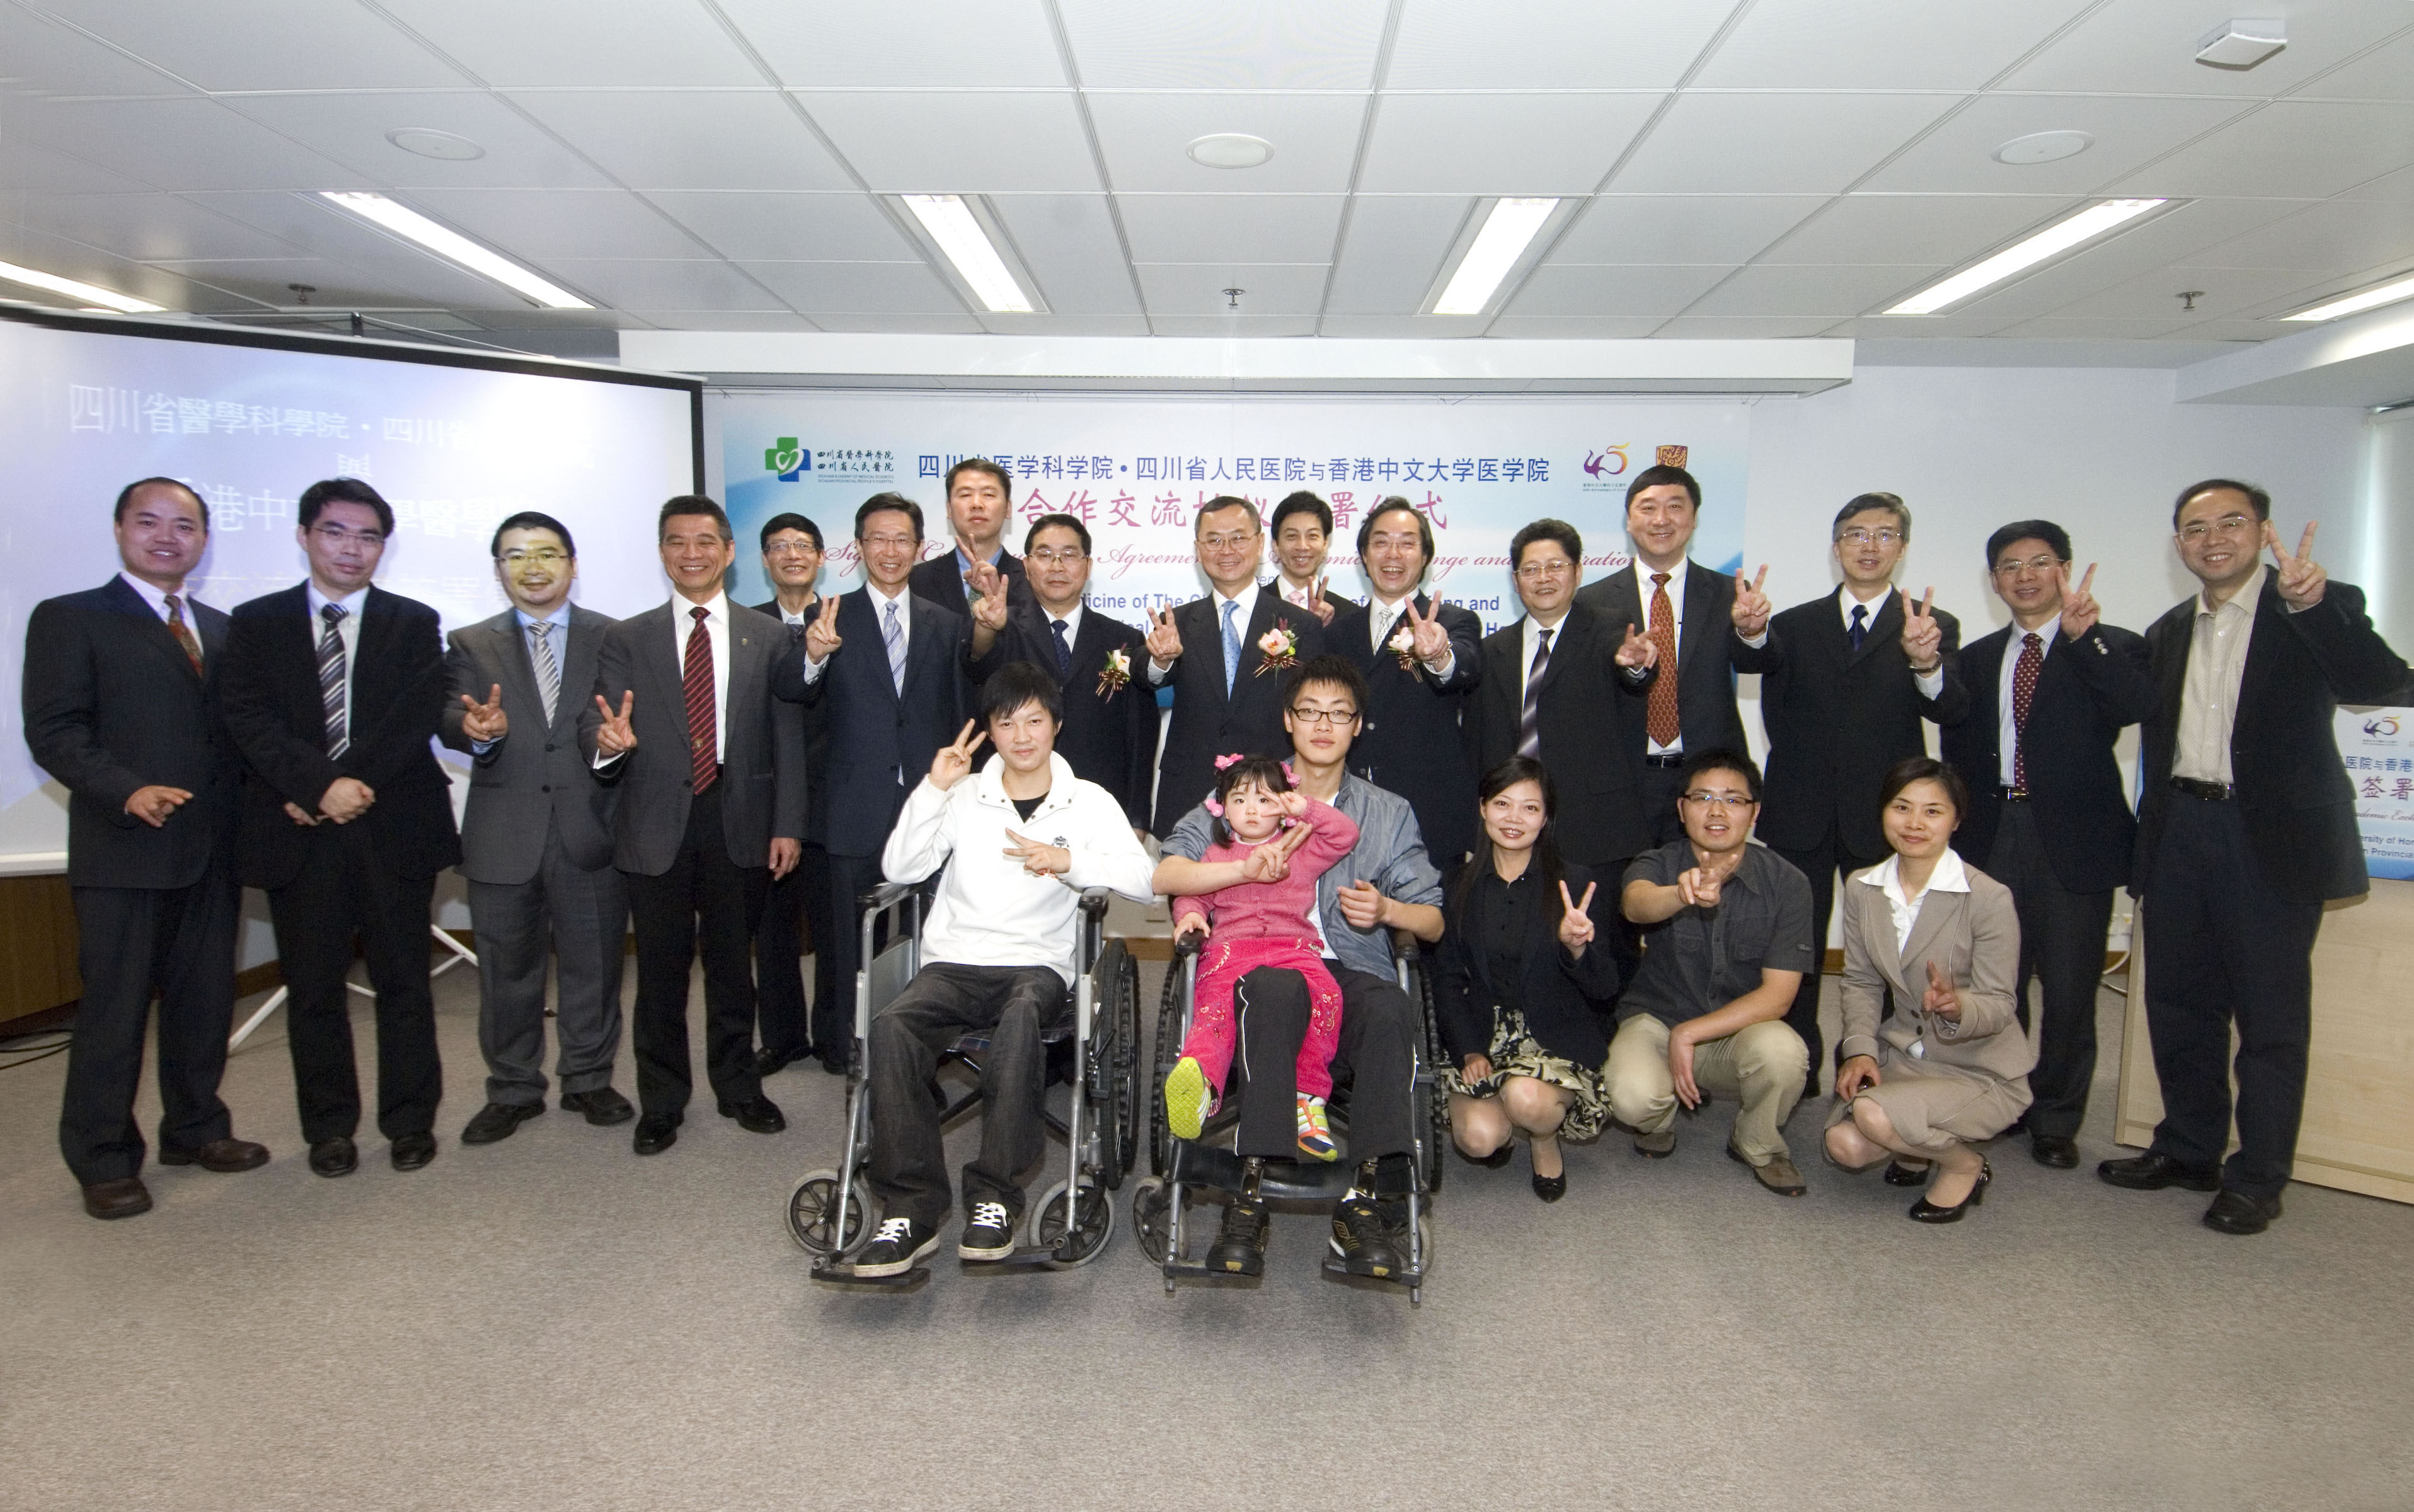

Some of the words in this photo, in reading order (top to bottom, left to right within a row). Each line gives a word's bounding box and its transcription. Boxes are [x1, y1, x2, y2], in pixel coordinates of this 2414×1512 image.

[817, 449, 894, 461] 四川省醫學科學院
[817, 461, 894, 472] 四川省人民醫院
[919, 454, 1549, 483] 四川医学科学院·四川省人民医院与香港中文大学医学院
[1097, 544, 1201, 580] Agreeme
[1083, 593, 1126, 608] icine
[1132, 594, 1148, 608] of
[1154, 593, 1183, 609] The
[1469, 596, 1500, 610] and
[2360, 776, 2414, 801] 签署
[2359, 835, 2384, 845] ersity
[2399, 837, 2414, 845] Ho
[2371, 847, 2414, 859] Provincia
